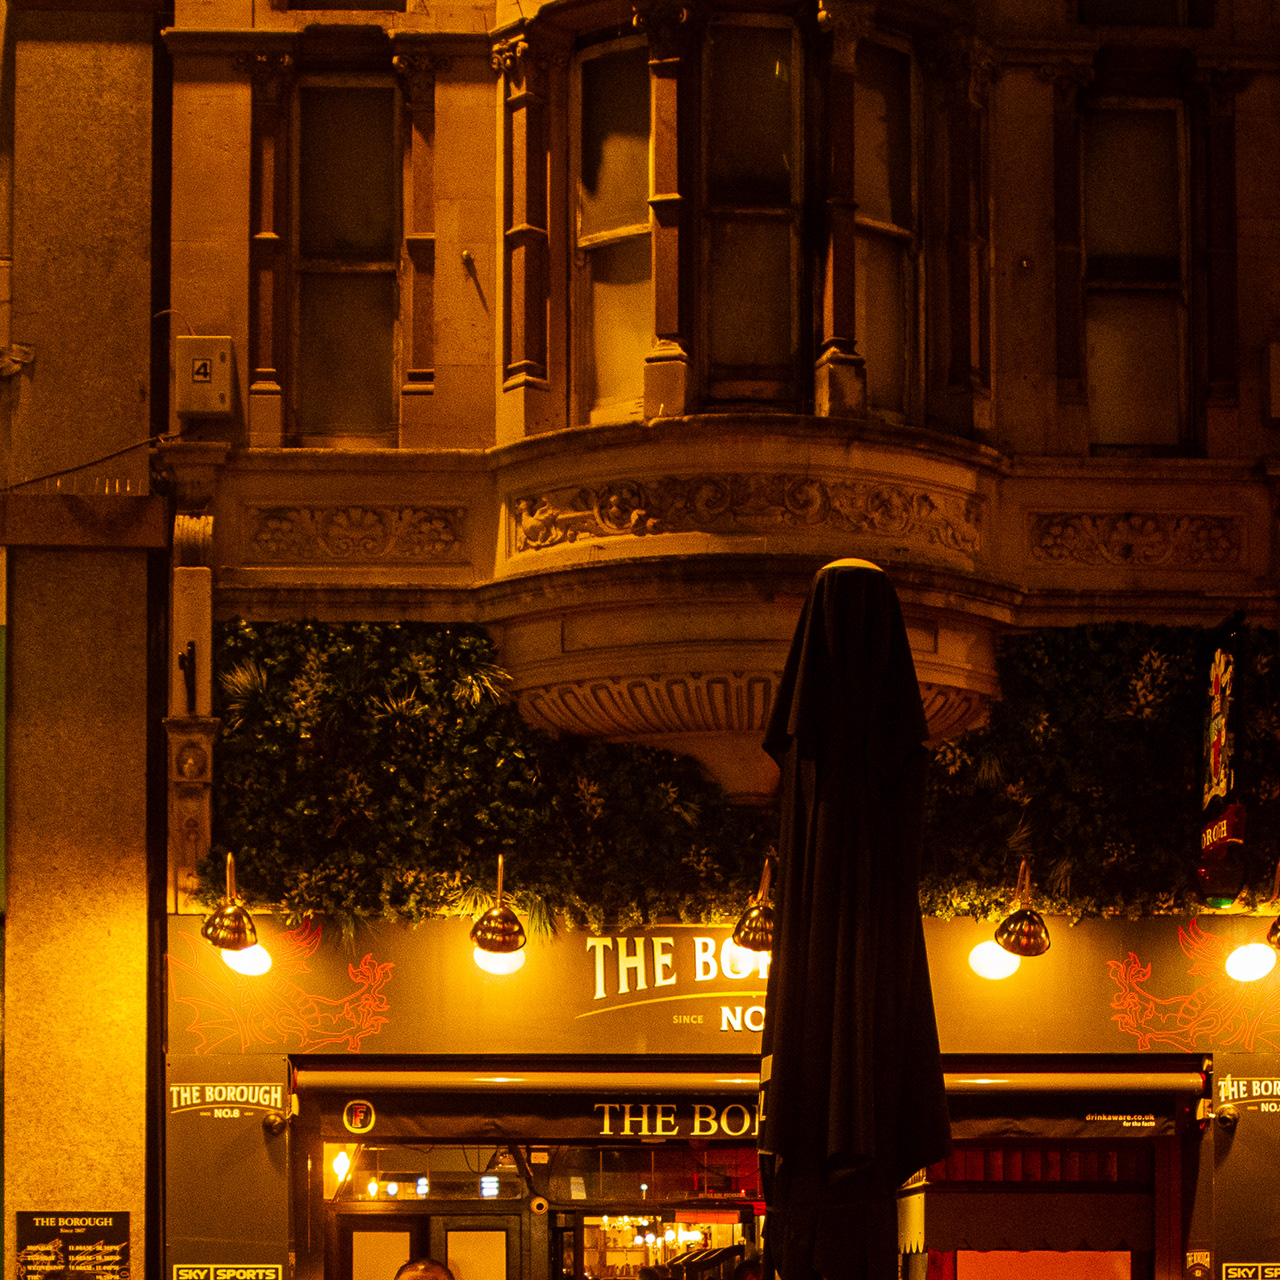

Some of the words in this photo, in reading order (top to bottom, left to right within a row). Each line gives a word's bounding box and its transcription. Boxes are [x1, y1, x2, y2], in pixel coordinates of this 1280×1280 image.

[195, 362, 208, 378] 4
[586, 937, 677, 1000] THE
[672, 1015, 704, 1024] SINCE
[1218, 1080, 1248, 1102] THE
[170, 1086, 201, 1108] THE
[205, 1086, 282, 1108] BOROUGH
[214, 1109, 240, 1118] NO.8
[1085, 1113, 1155, 1121] drinkaware.co.uk
[594, 1104, 679, 1135] THE
[33, 1217, 56, 1226] THE
[58, 1217, 113, 1227] BOROUGH
[178, 1269, 208, 1280] SKY
[216, 1269, 276, 1280] SPORTS
[1227, 1267, 1256, 1278] SKY
